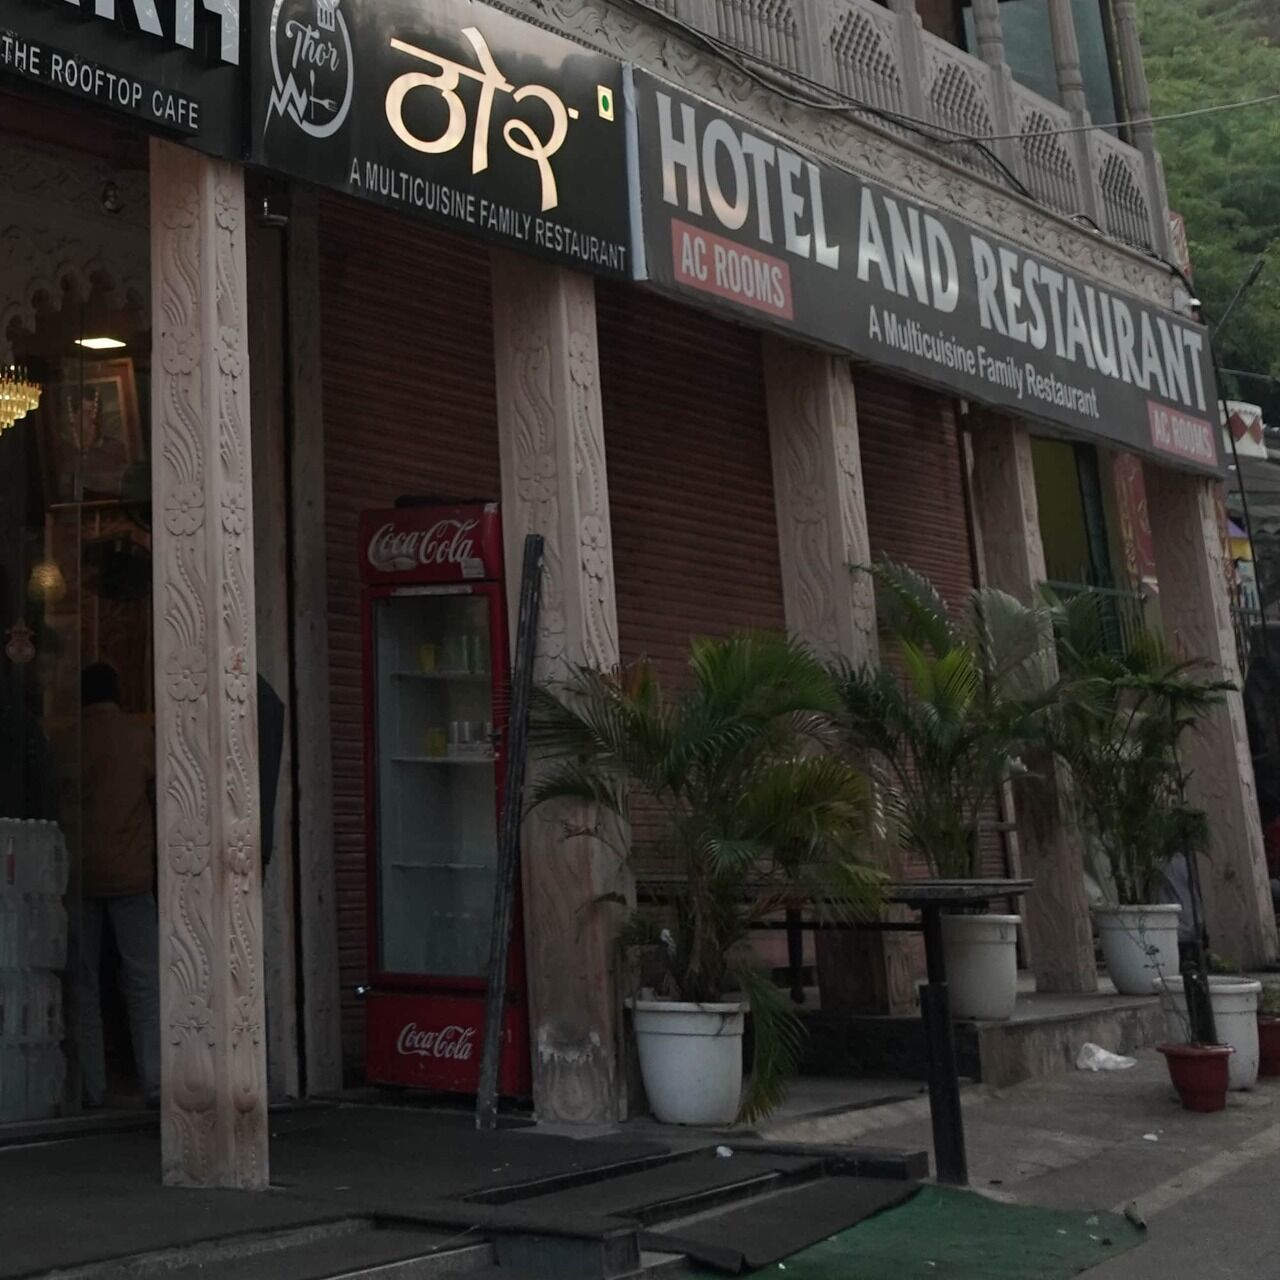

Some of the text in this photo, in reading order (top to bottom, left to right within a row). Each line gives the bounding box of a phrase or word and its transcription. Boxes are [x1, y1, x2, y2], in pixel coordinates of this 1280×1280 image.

[1, 35, 200, 129] THE ROOFTOP CAFE
[286, 19, 340, 72] Thor
[349, 157, 626, 271] A MULTICUISINE FAMILY RESTAURANT
[656, 91, 1207, 412] HOTEL AND RESTAURANT
[681, 233, 786, 309] AC ROOMS
[869, 305, 1100, 419] A Multicuisine Family Restaurant
[1154, 409, 1214, 459] AC ROOMS
[368, 519, 480, 572] Coca-Cola
[397, 1022, 477, 1060] Coca-Cola
